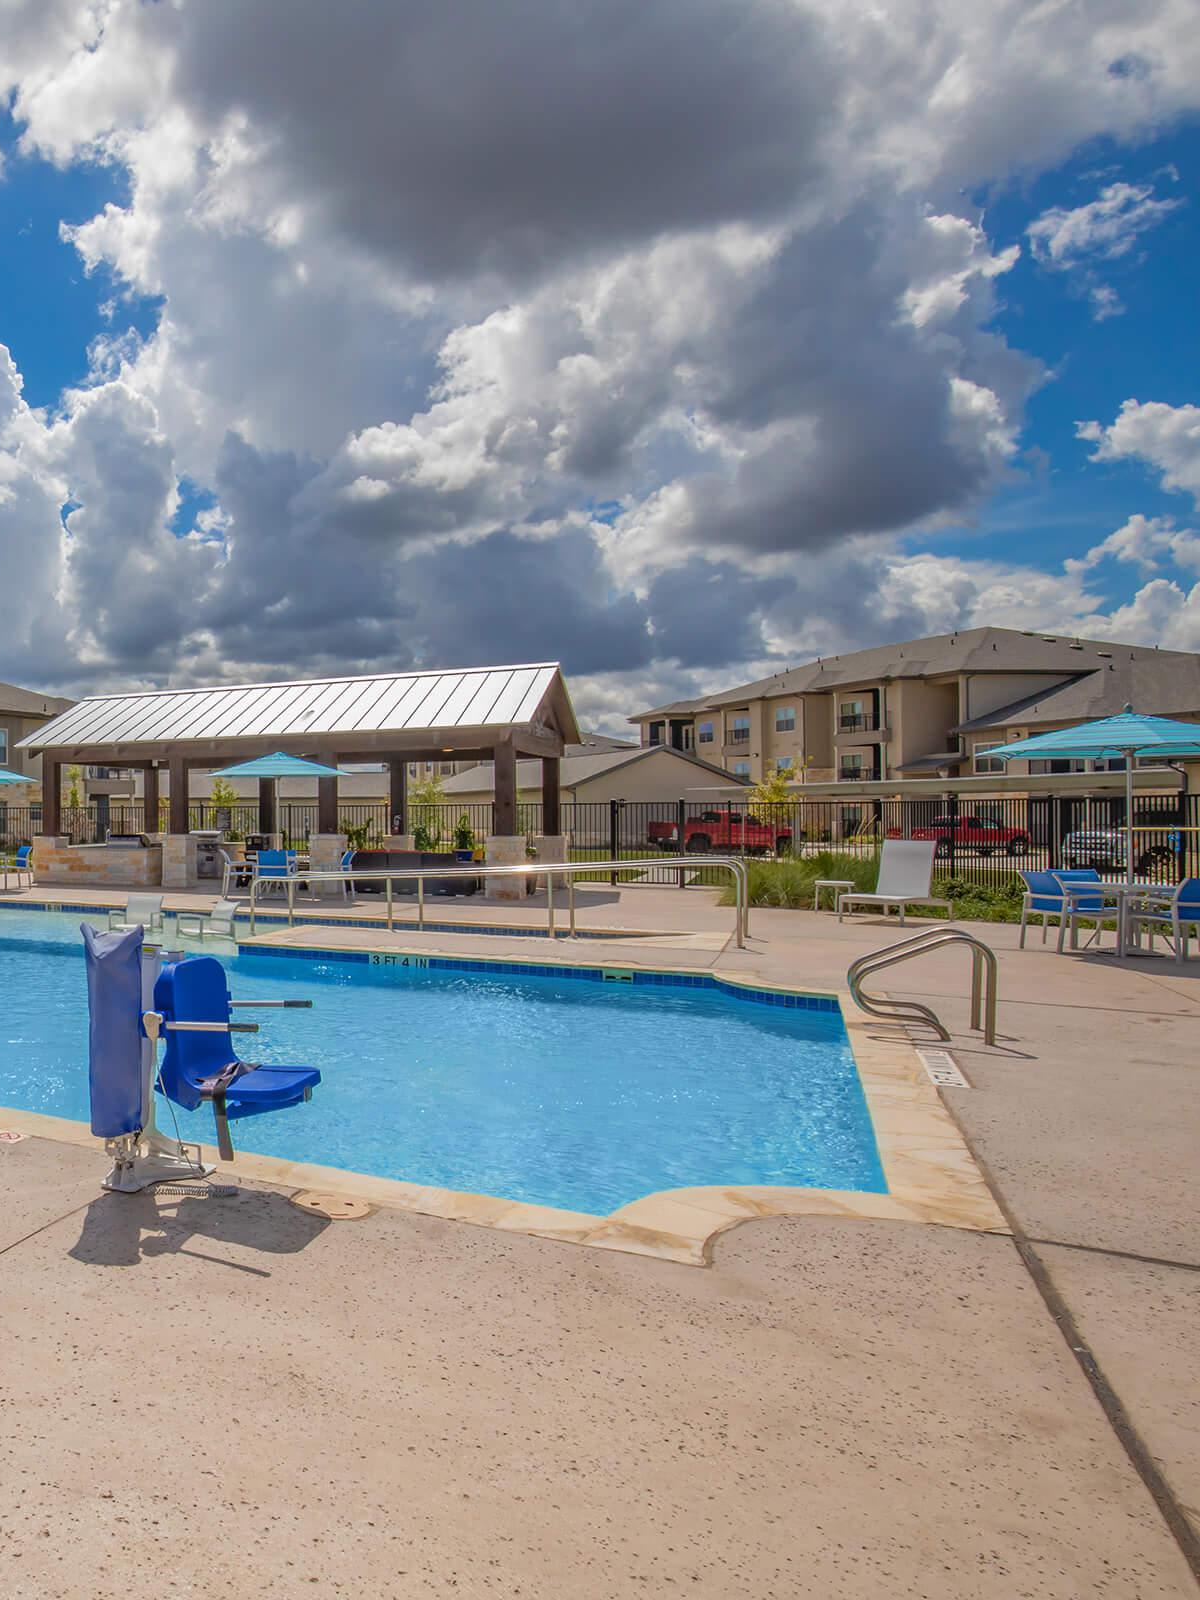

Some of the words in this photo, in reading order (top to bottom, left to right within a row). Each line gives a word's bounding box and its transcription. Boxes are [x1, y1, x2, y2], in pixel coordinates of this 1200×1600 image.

[372, 955, 381, 965] 3
[384, 955, 398, 966] FT
[401, 957, 410, 967] 4
[415, 958, 427, 969] IN
